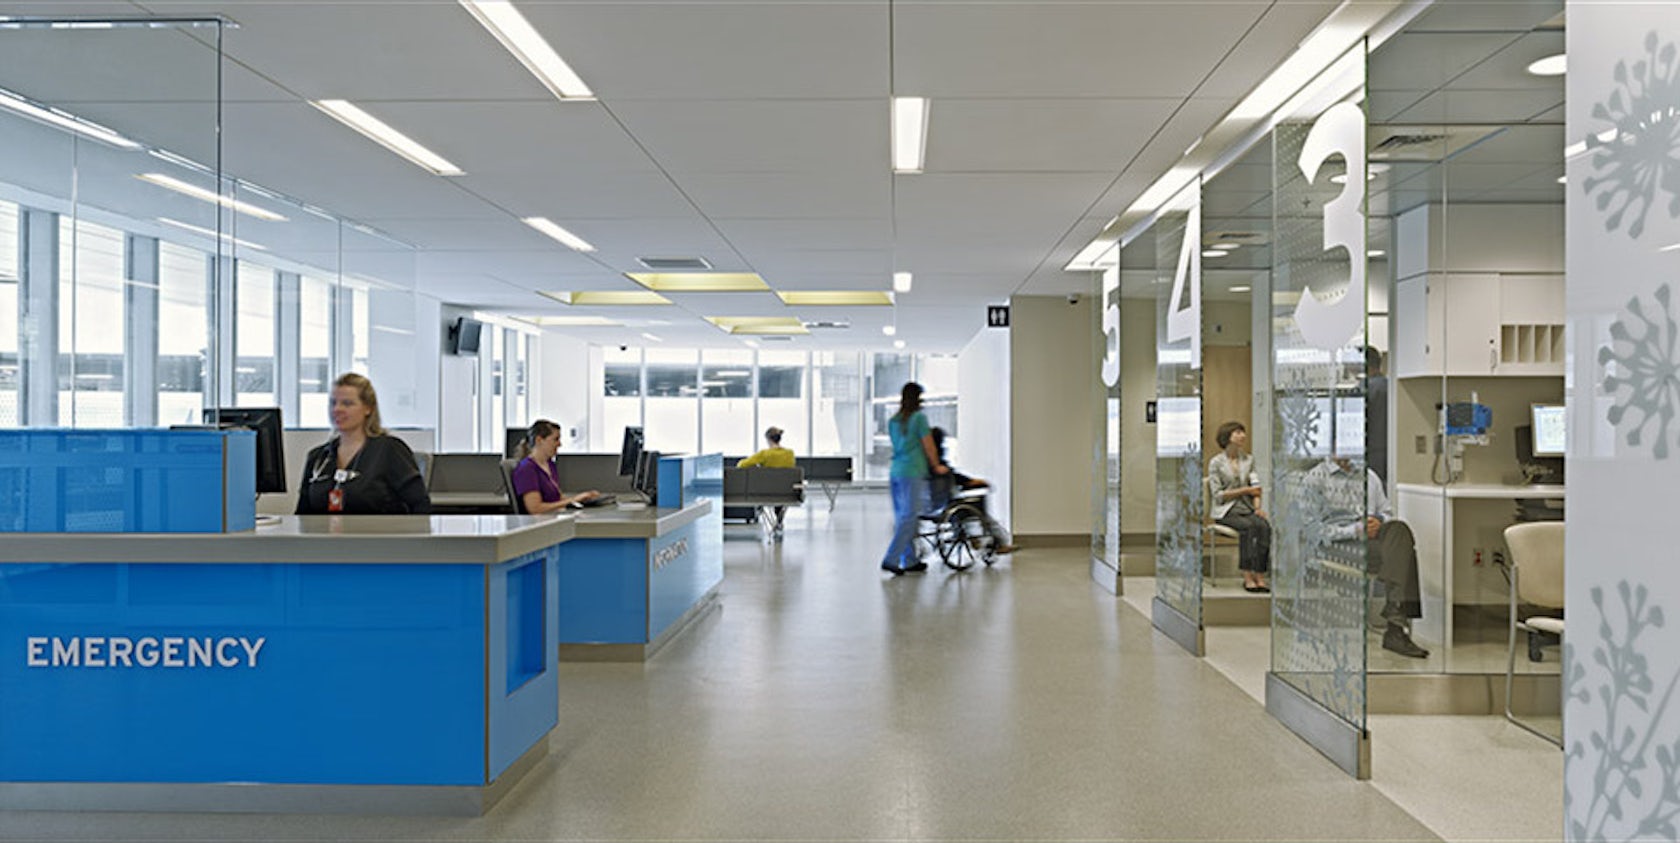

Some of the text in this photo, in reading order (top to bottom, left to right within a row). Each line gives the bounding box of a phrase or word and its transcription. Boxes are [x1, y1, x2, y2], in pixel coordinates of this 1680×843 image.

[1167, 200, 1201, 370] 4
[1295, 102, 1366, 350] 3
[1101, 264, 1120, 387] 5
[27, 637, 265, 667] EMERGENCY
